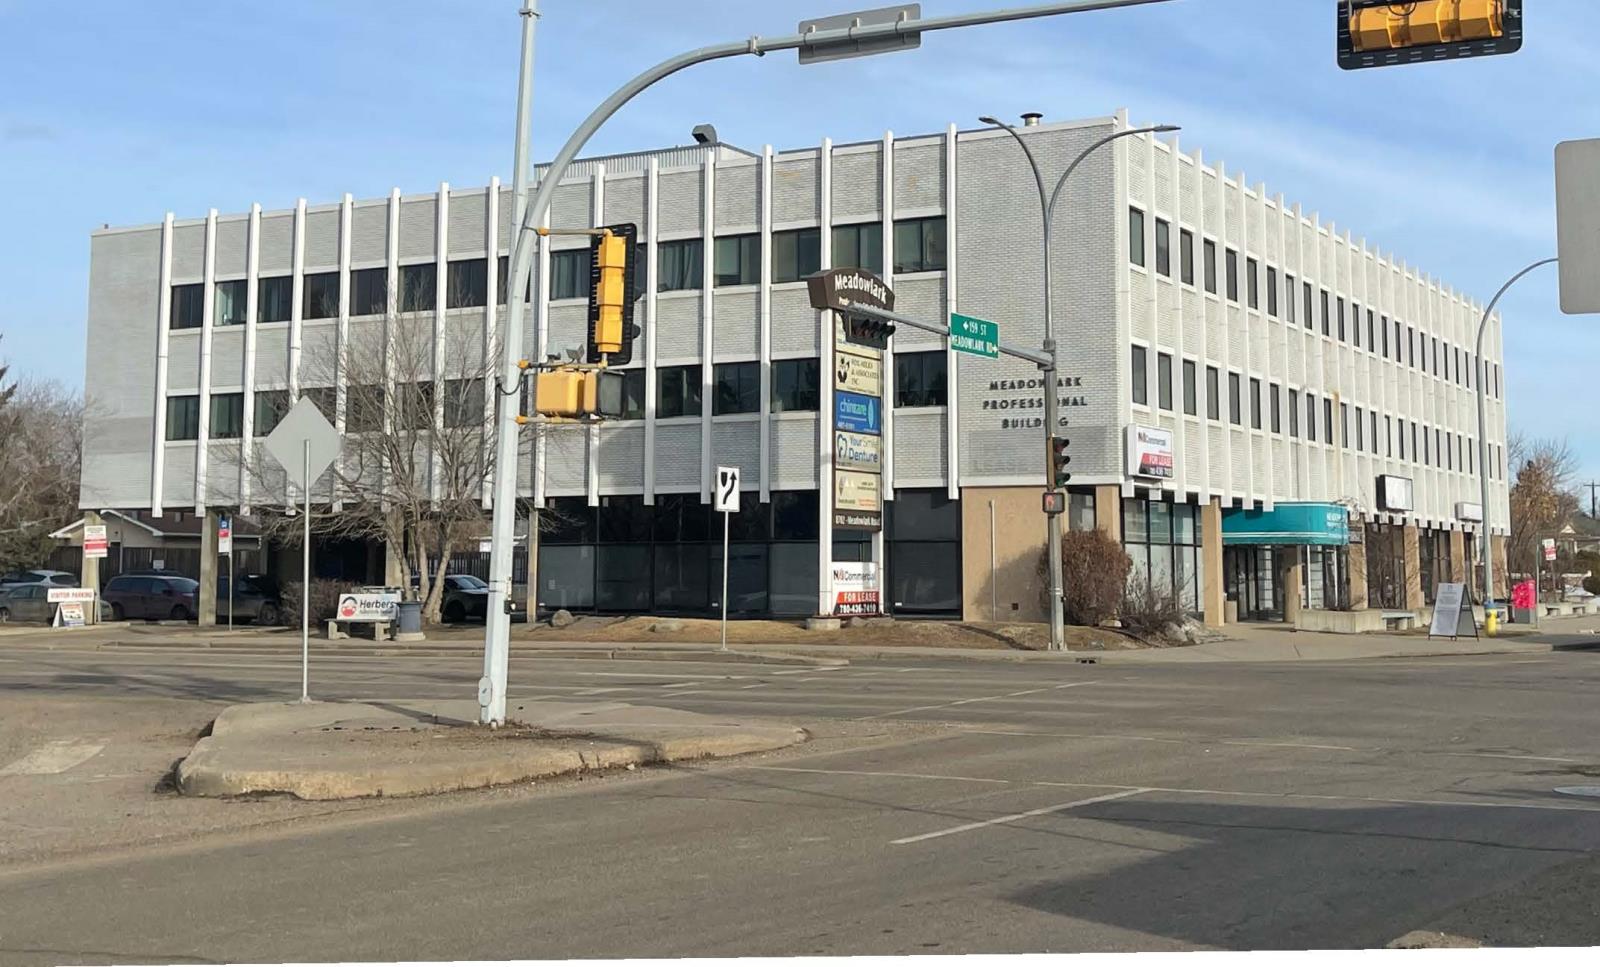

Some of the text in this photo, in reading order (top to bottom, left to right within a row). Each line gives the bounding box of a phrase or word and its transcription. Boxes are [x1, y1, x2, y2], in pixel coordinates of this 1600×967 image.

[834, 272, 887, 305] Meadowlark
[969, 321, 987, 336] 159 ST
[989, 377, 1082, 390] MEADOWARK
[982, 396, 1088, 409] PROFESSNAL
[1002, 417, 1069, 429] BUILDG
[849, 447, 879, 463] Denture
[844, 592, 876, 602] FOR LEASE
